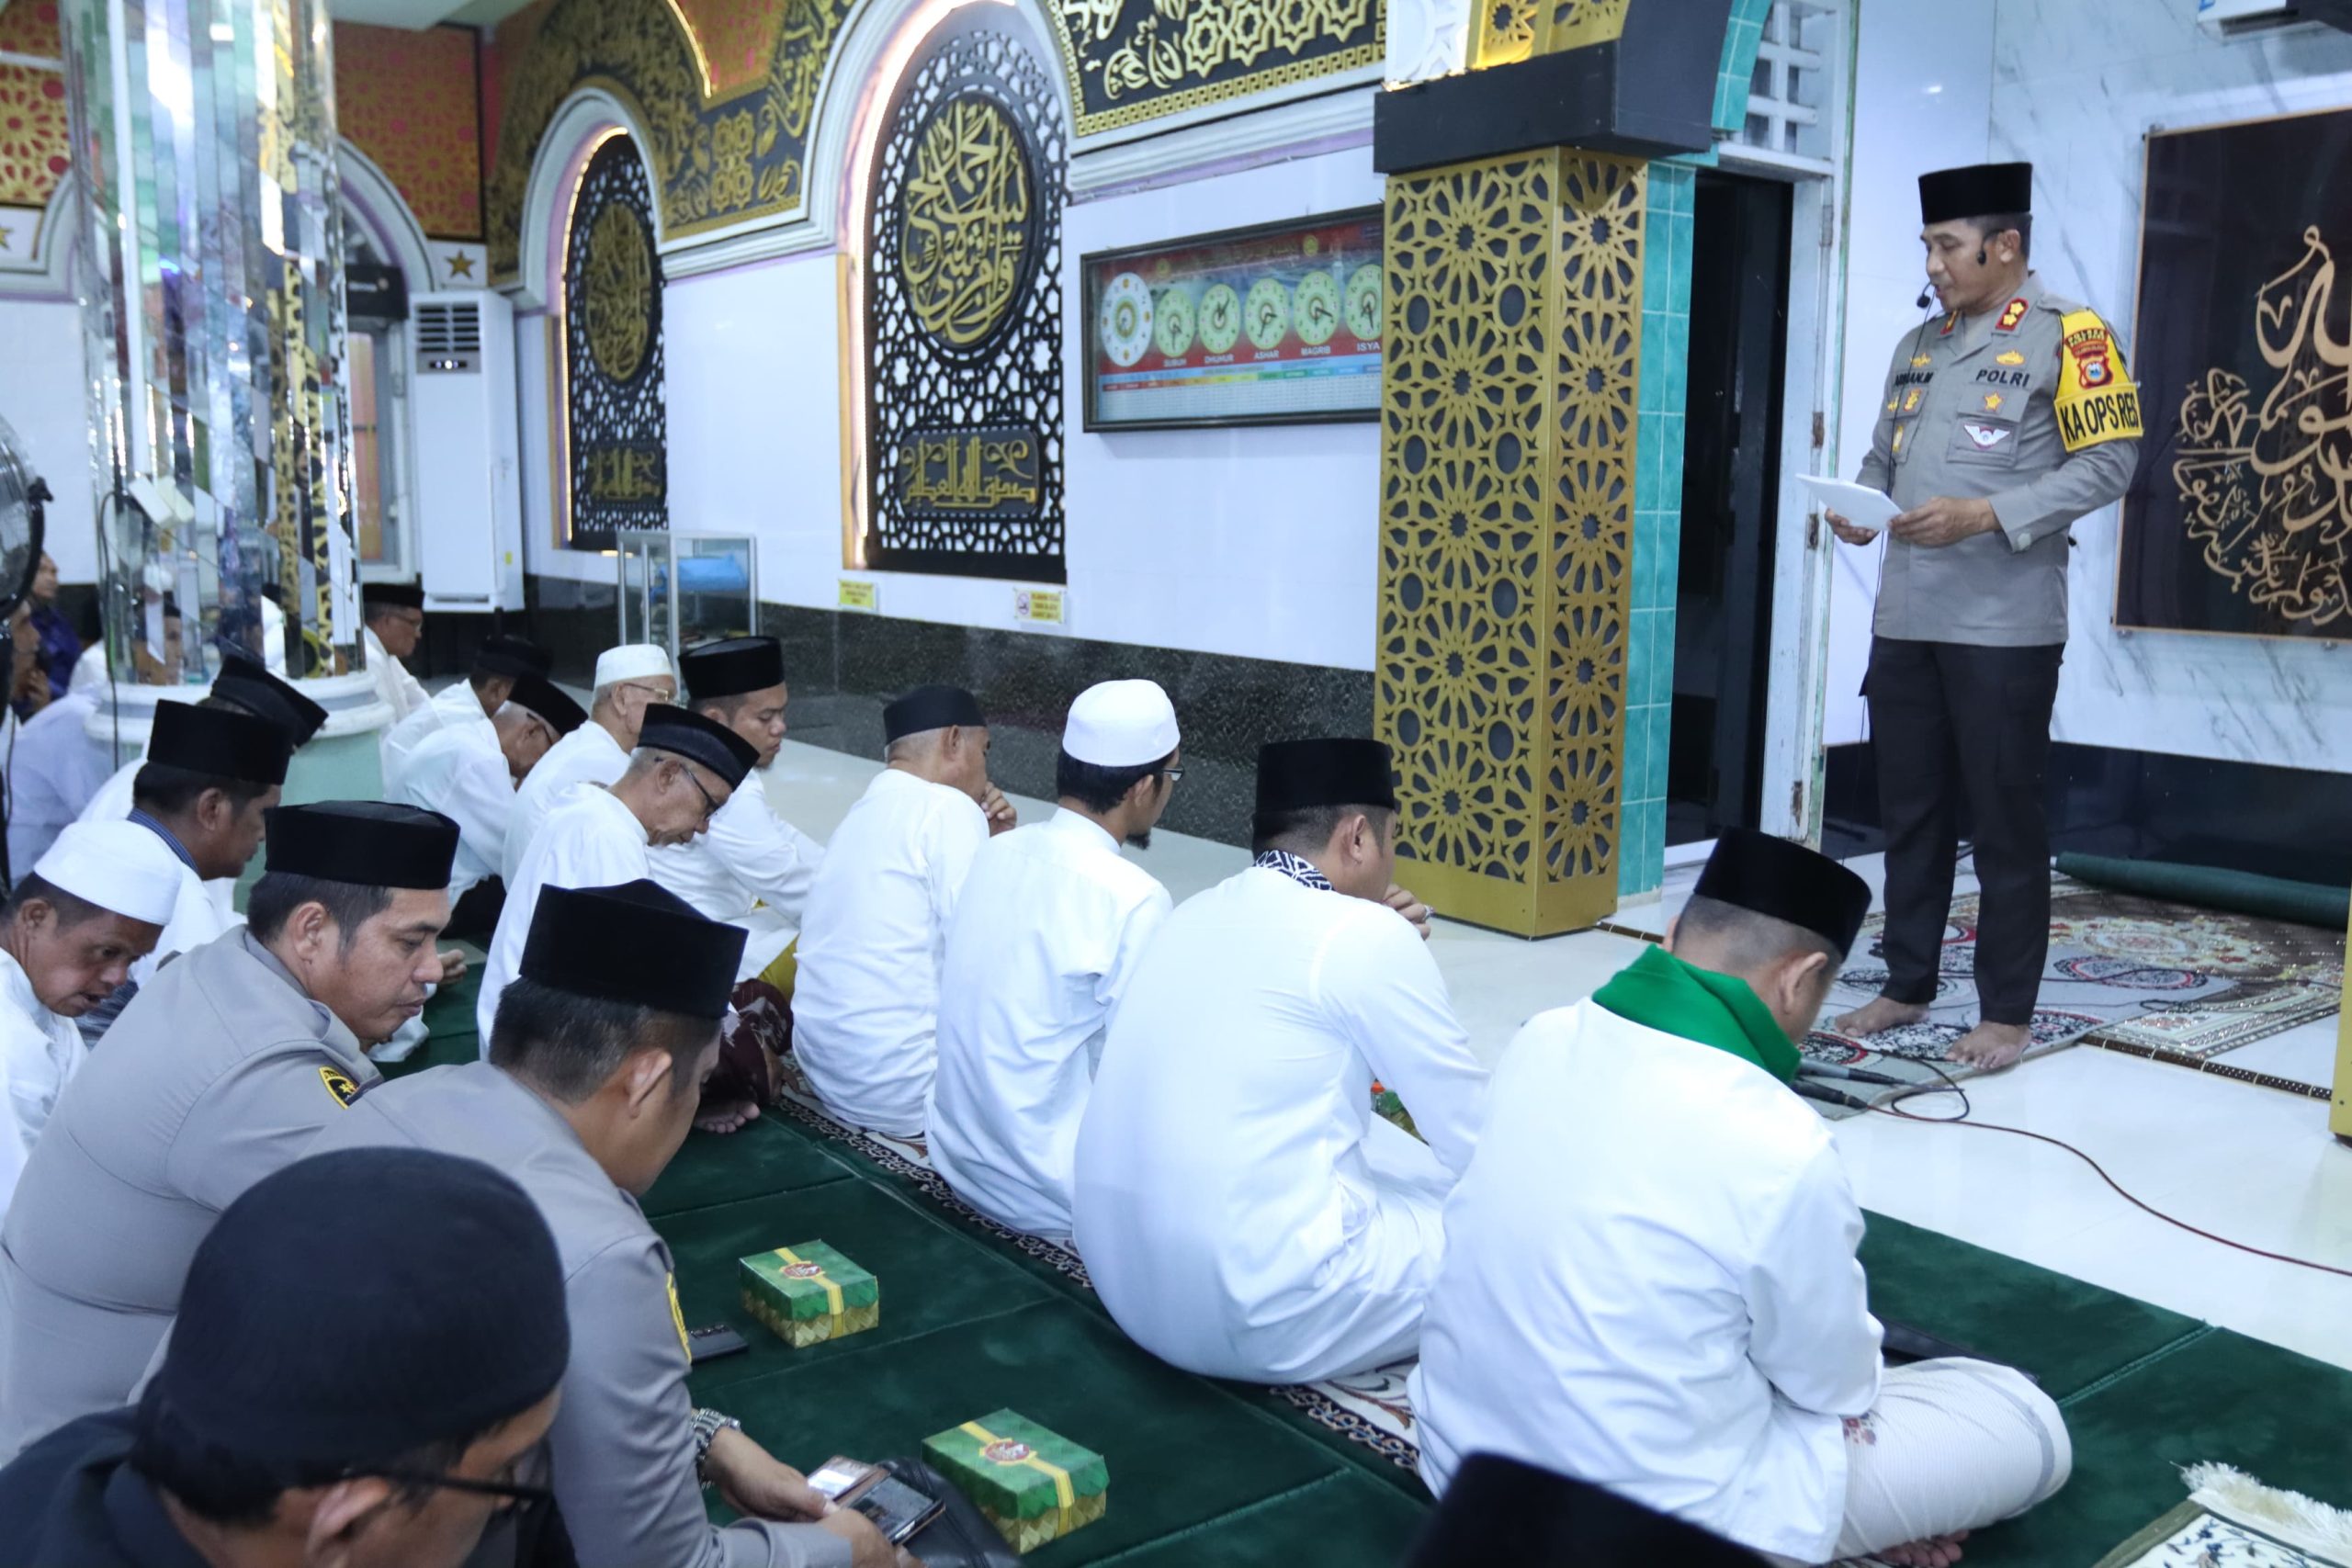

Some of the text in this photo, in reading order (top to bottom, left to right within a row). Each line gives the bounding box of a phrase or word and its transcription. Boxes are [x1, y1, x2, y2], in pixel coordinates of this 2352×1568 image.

[1301, 345, 1331, 356] MAGRIB
[1357, 342, 1381, 352] ISYA
[1254, 350, 1279, 360] ASHAR
[1975, 368, 2030, 388] POLRI
[2060, 401, 2086, 443] KA
[2084, 394, 2120, 435] OPS
